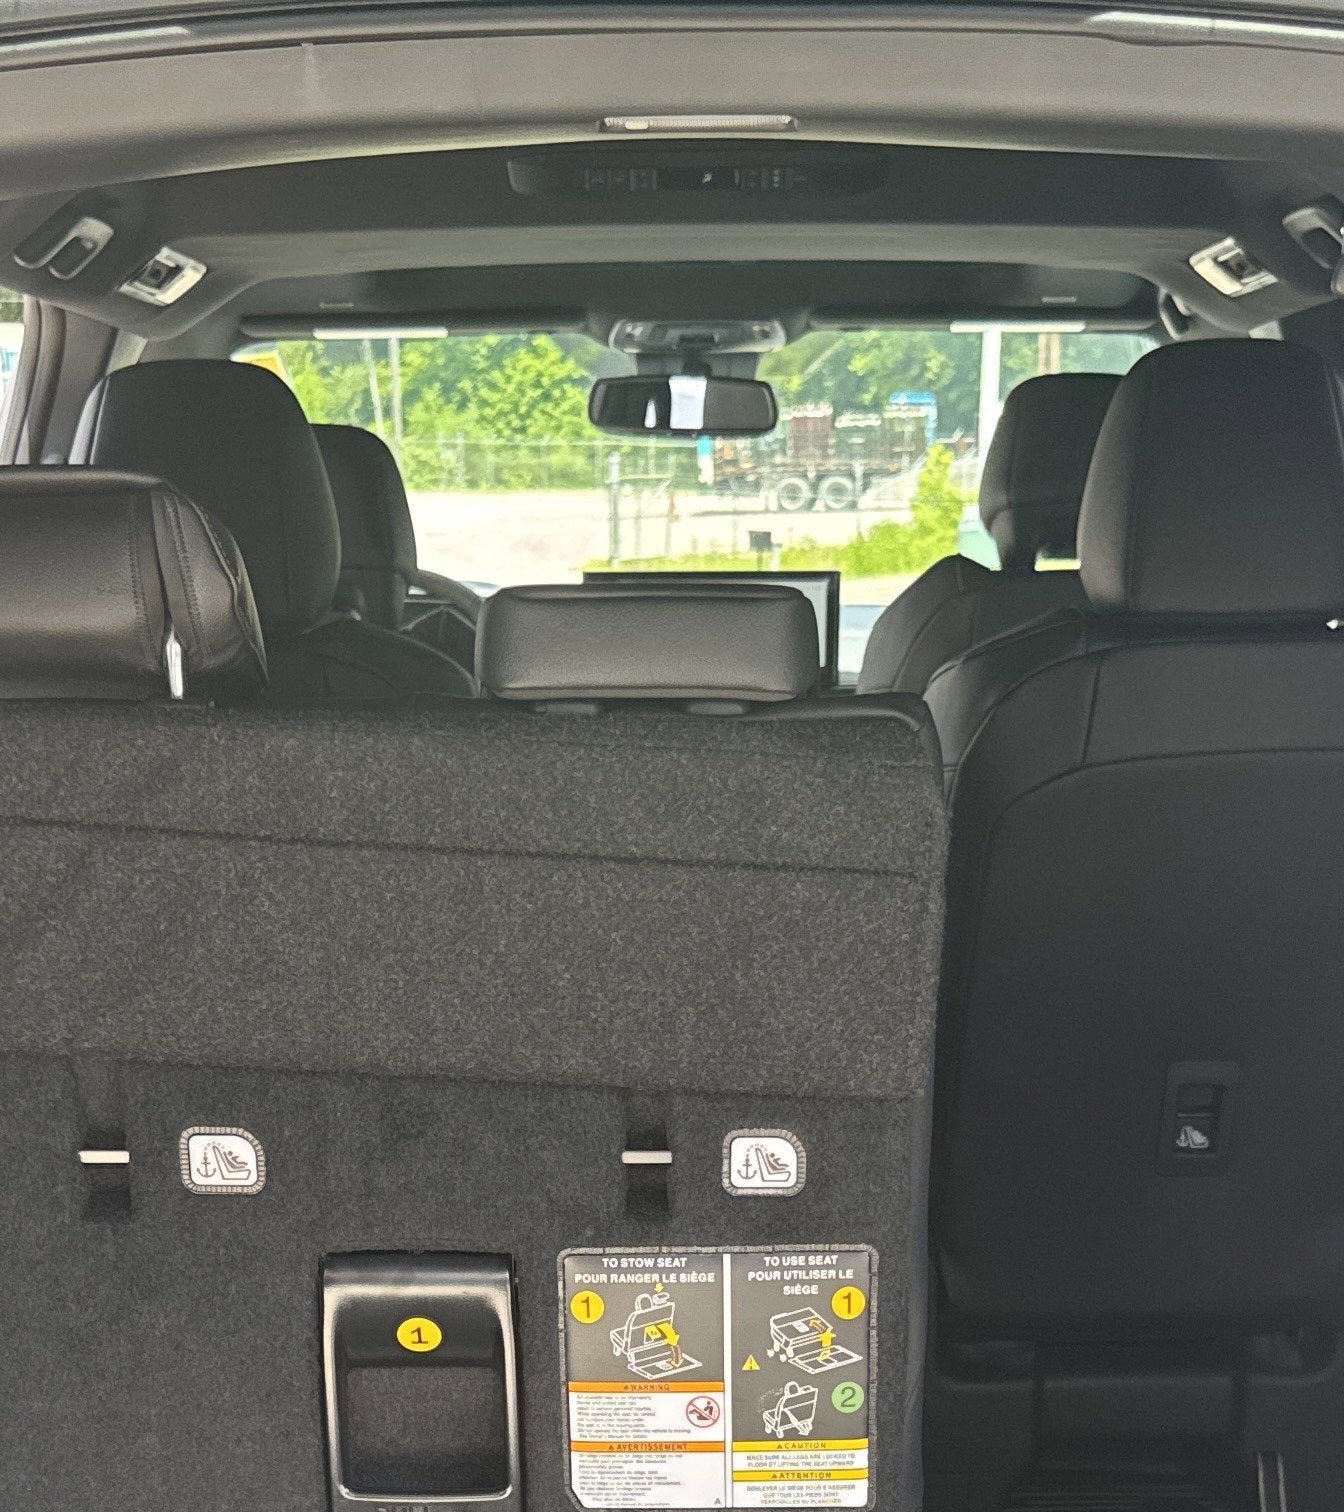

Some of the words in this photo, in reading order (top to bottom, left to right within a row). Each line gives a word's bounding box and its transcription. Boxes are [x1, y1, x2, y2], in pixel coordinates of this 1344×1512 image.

[602, 1258, 617, 1268] TO
[620, 1257, 655, 1268] STOW
[656, 1257, 687, 1268] SEAT
[764, 1256, 780, 1266] TO
[782, 1256, 806, 1266] USE
[808, 1255, 838, 1266] SEAT
[574, 1273, 607, 1283] POUR
[610, 1273, 660, 1283] RANGER
[662, 1273, 677, 1283] LE
[679, 1271, 715, 1283] SIÈGE
[748, 1271, 781, 1281] POUR
[783, 1269, 837, 1280] UTILISER
[838, 1269, 854, 1279] LE
[783, 1283, 819, 1295] SIÈGE
[580, 1296, 591, 1318] 1
[841, 1291, 852, 1315] 1
[410, 1326, 429, 1345] 1
[630, 1384, 670, 1392] WARNING
[841, 1388, 856, 1408] 2
[617, 1443, 688, 1451] AVERTISSEMENT
[784, 1442, 827, 1450] CAUTION
